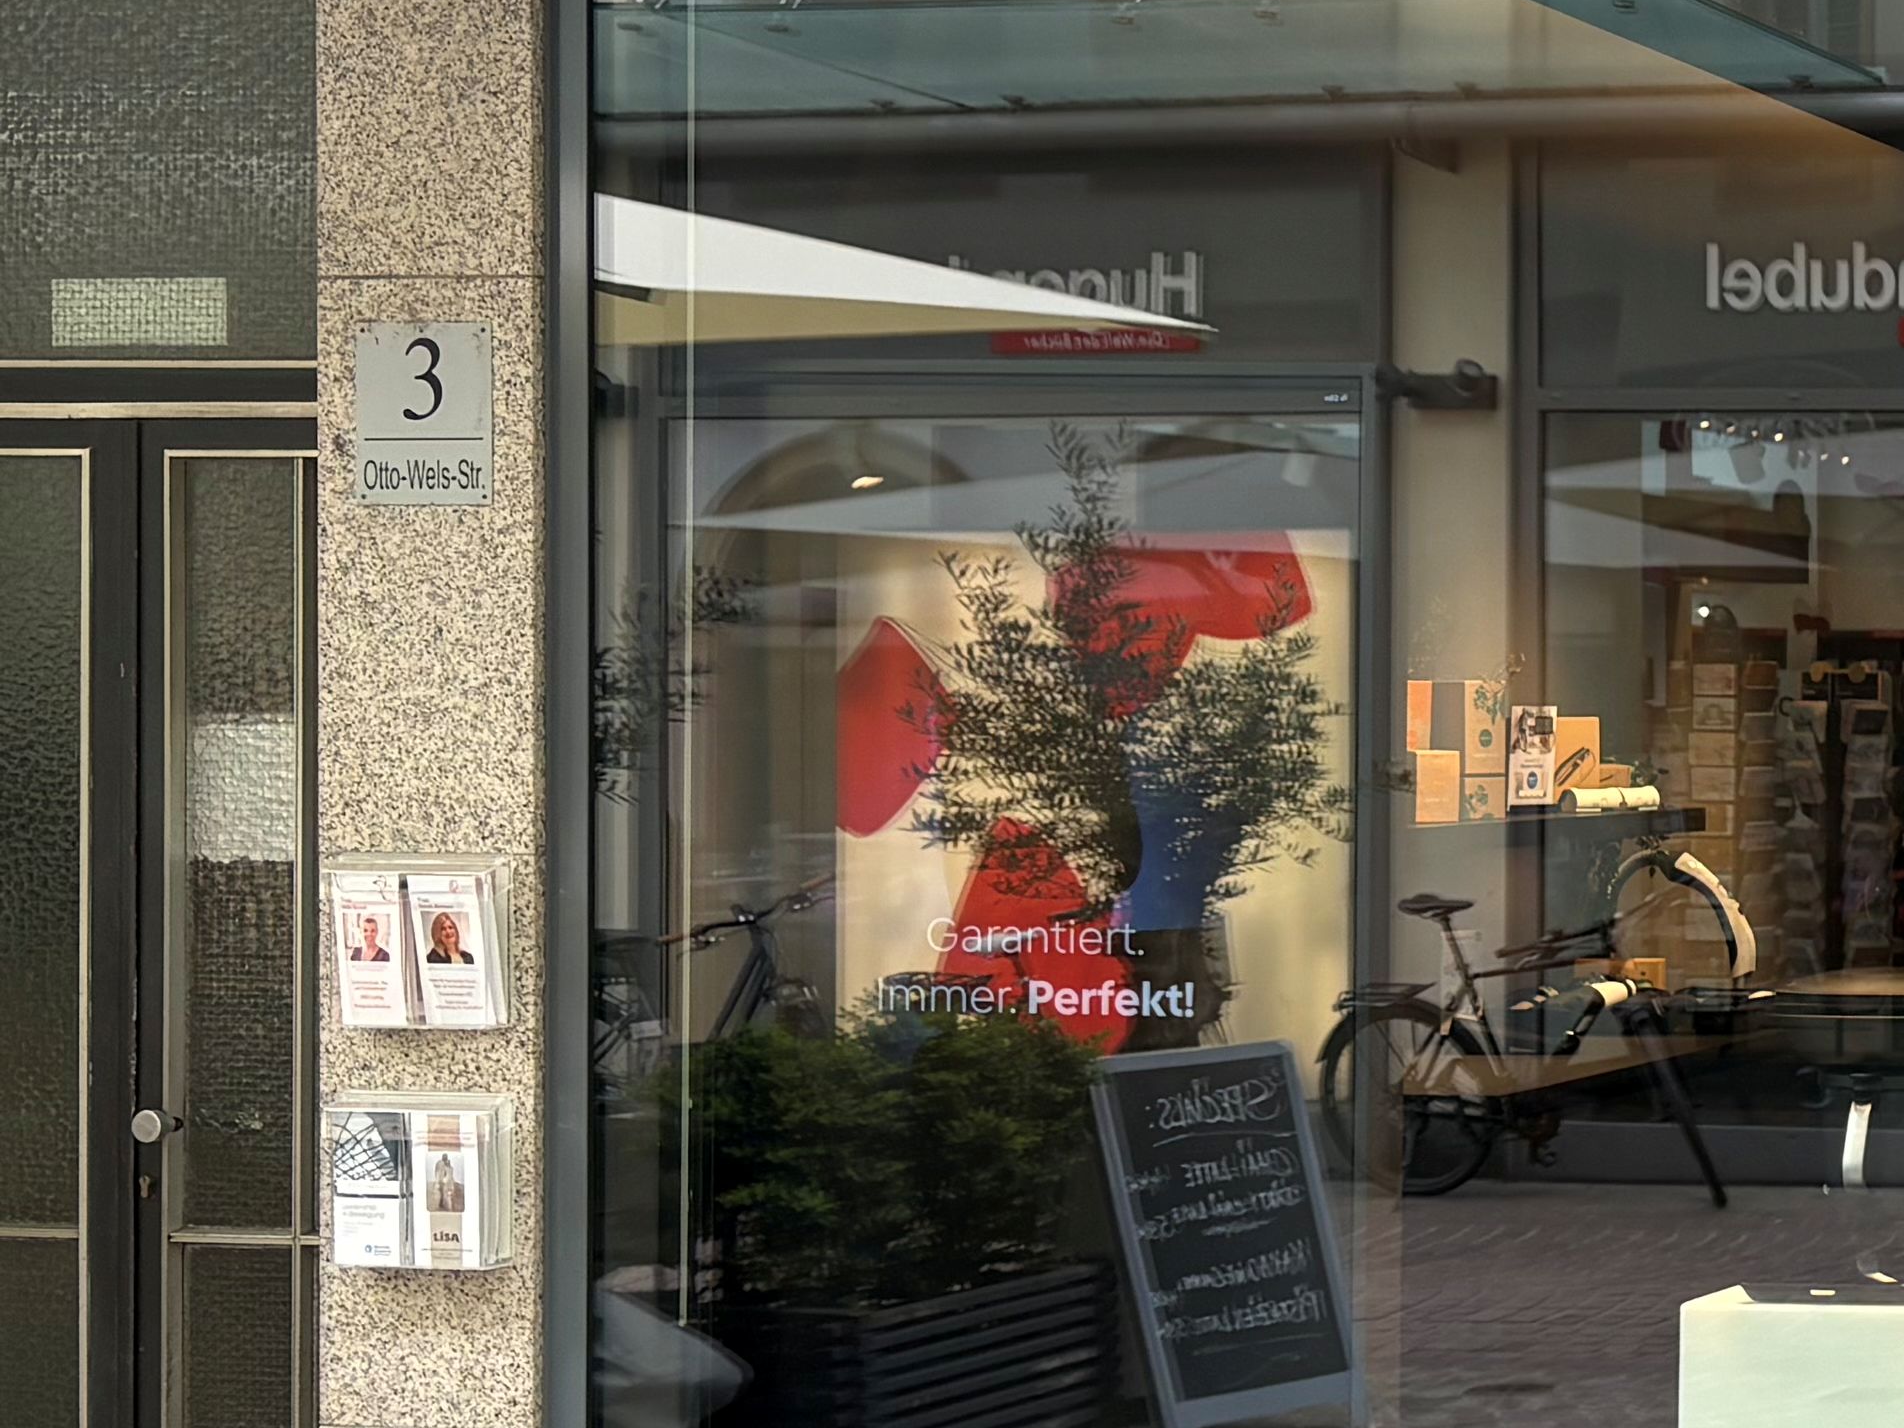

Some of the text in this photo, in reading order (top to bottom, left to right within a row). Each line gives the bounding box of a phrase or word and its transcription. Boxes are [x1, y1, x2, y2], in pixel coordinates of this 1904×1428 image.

[402, 337, 443, 421] 3
[363, 459, 486, 491] Otto-Wels-Str.
[926, 919, 1146, 957] Garantiert.
[877, 977, 1195, 1018] Immer. Perfekt!
